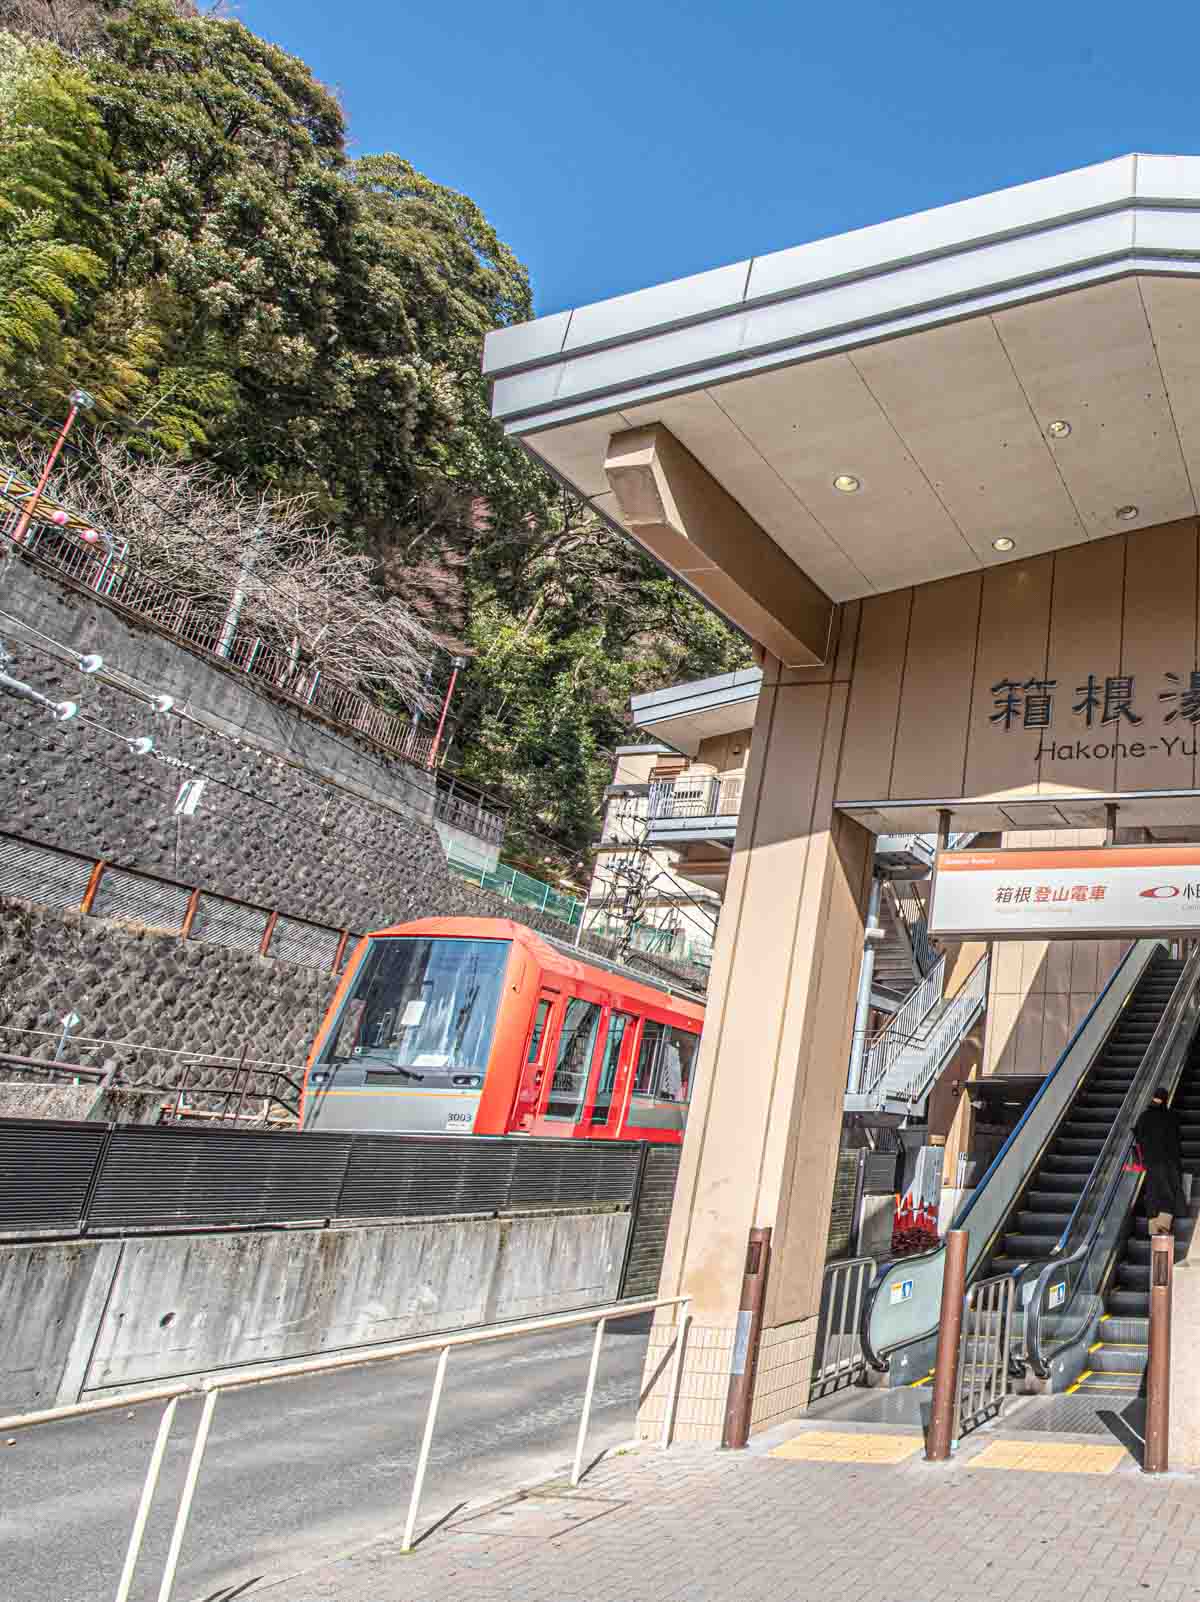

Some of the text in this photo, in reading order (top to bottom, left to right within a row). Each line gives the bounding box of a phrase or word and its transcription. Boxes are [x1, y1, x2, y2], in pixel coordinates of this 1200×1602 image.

[995, 884, 1107, 904] 箱根登山電車
[448, 1112, 472, 1122] 3003
